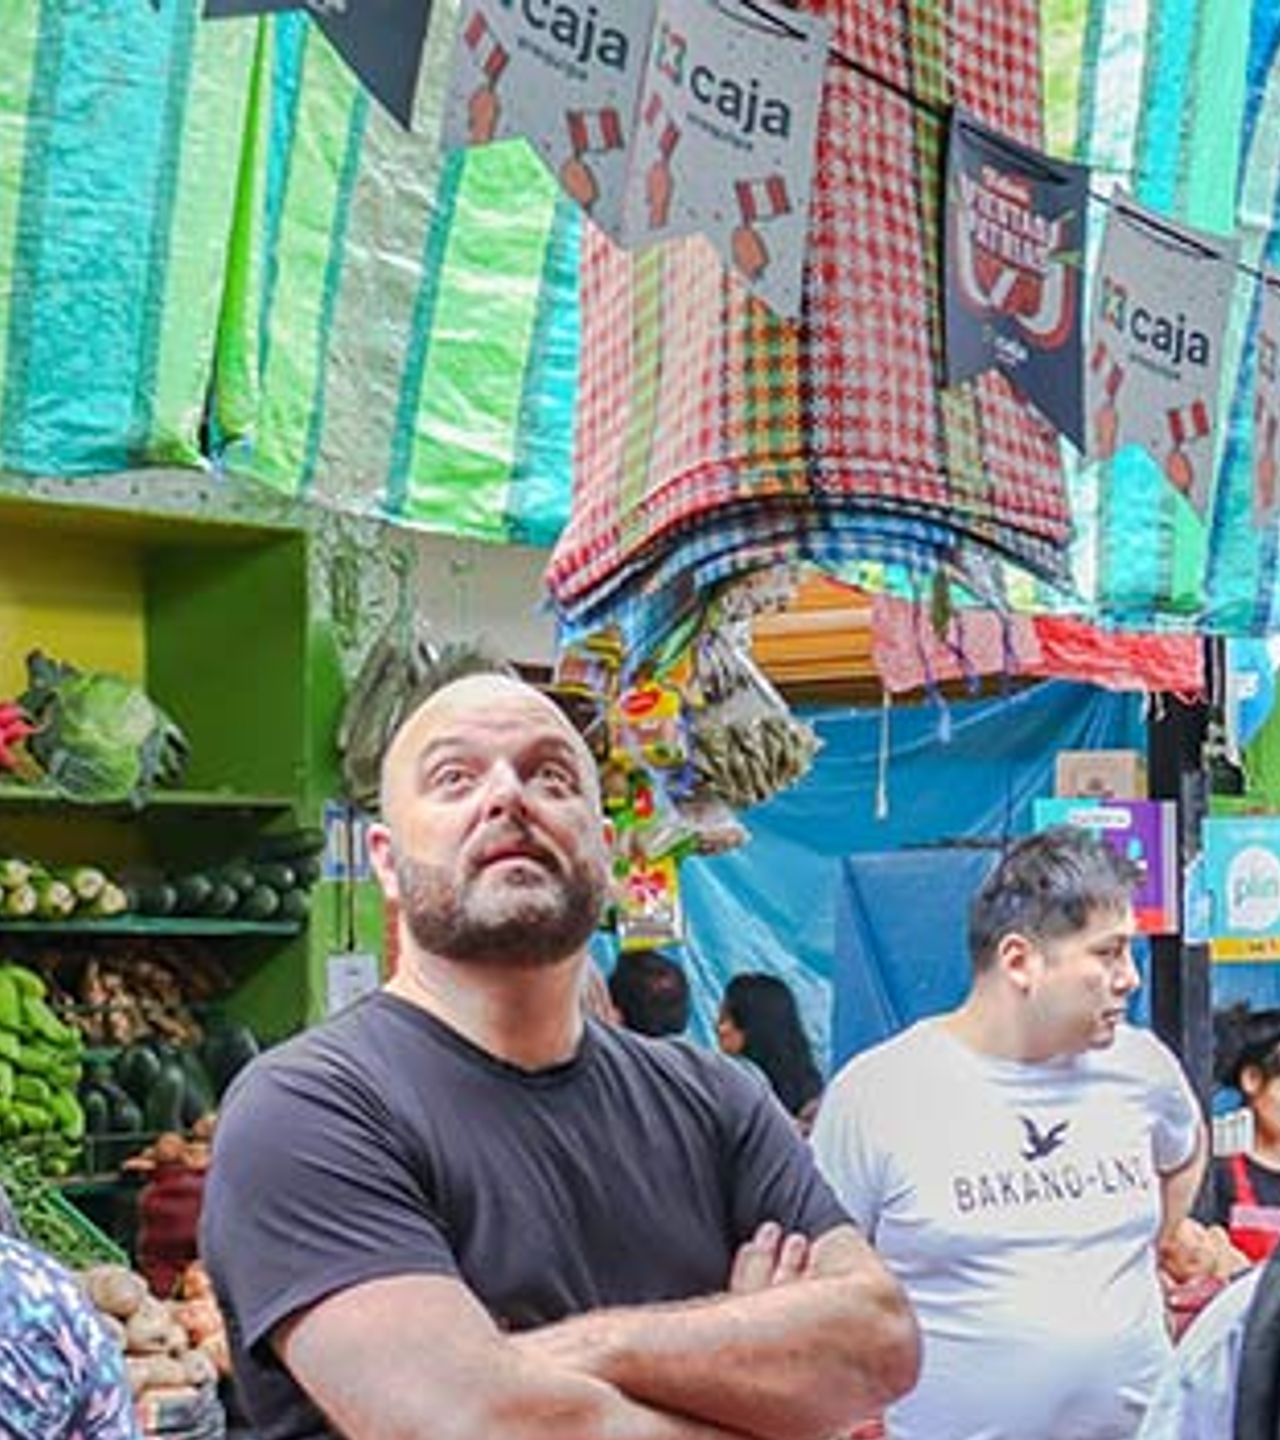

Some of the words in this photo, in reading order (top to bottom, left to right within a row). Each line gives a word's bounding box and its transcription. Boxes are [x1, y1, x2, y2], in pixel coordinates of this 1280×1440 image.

[520, 0, 629, 71] caja
[689, 65, 791, 138] caja
[1130, 307, 1210, 367] caja
